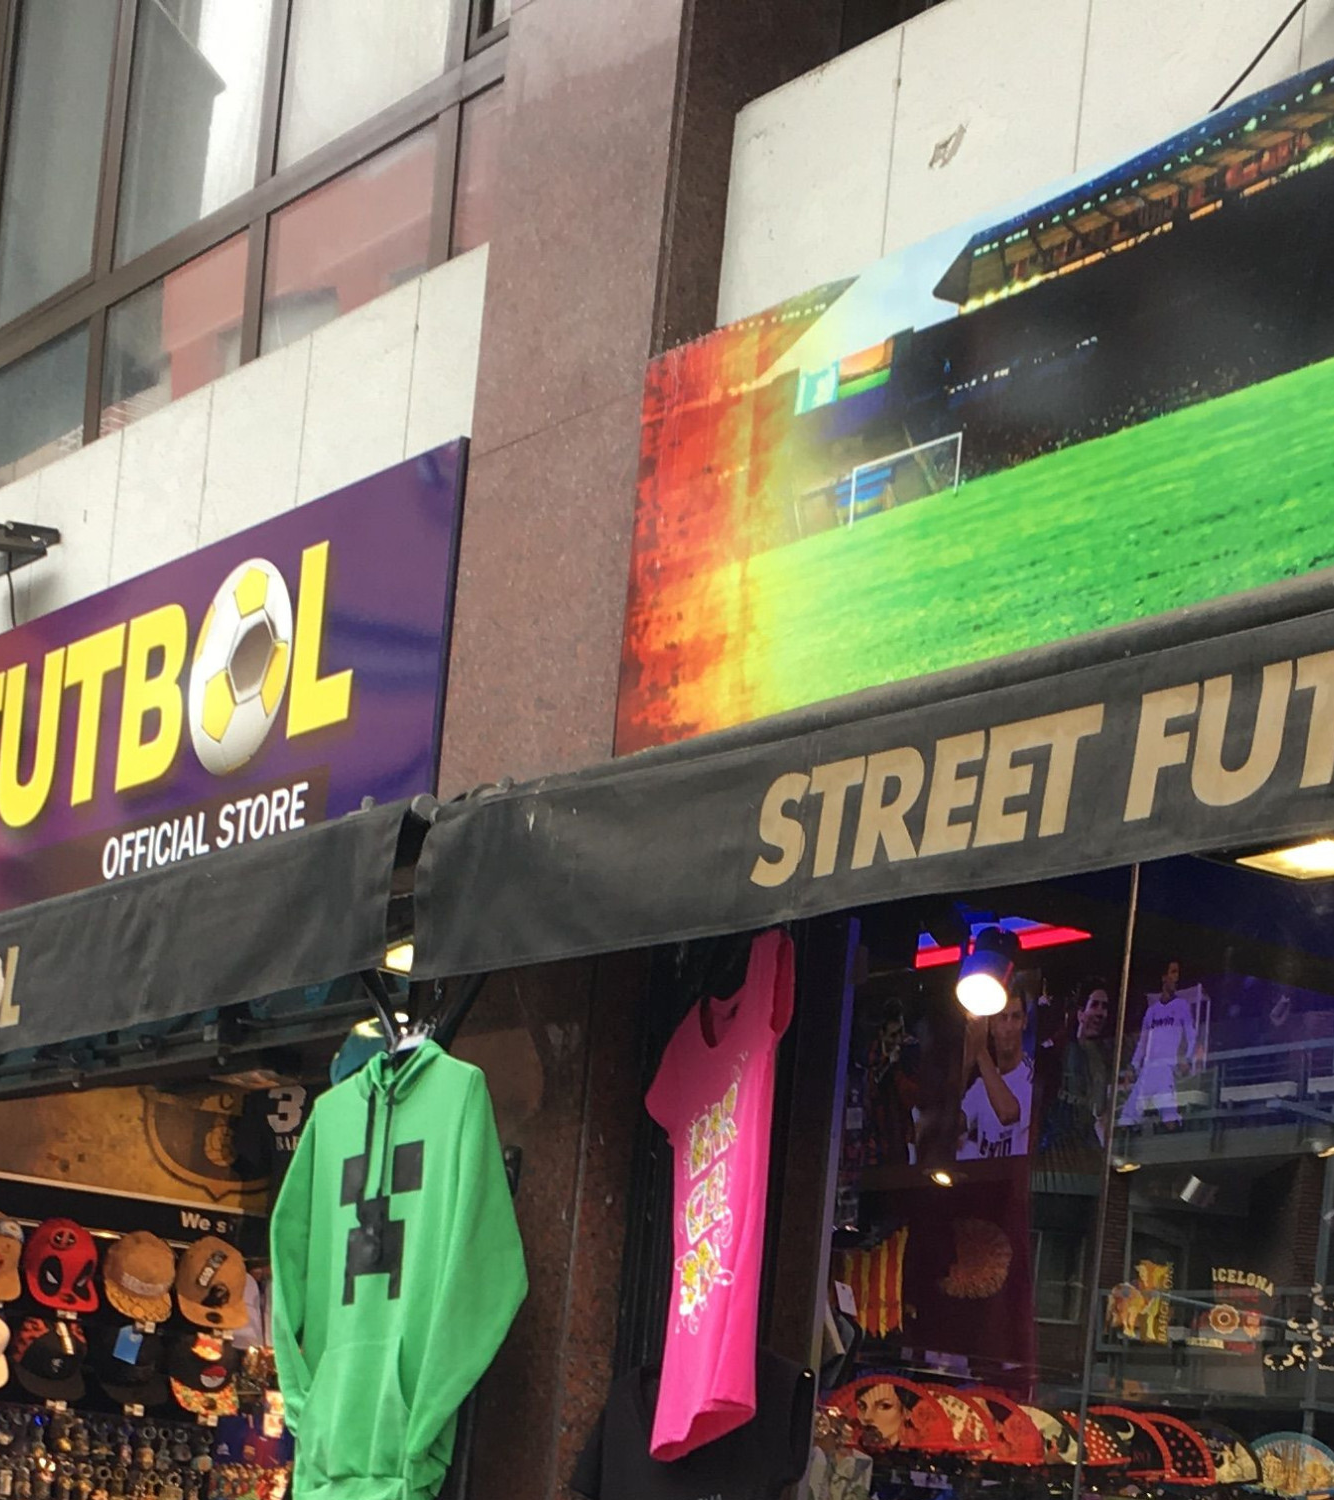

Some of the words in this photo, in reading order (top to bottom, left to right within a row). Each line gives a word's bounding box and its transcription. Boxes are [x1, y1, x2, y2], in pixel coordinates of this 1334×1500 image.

[101, 807, 212, 882] OFFICIAL
[214, 781, 310, 850] STORE
[749, 703, 1103, 889] STREET
